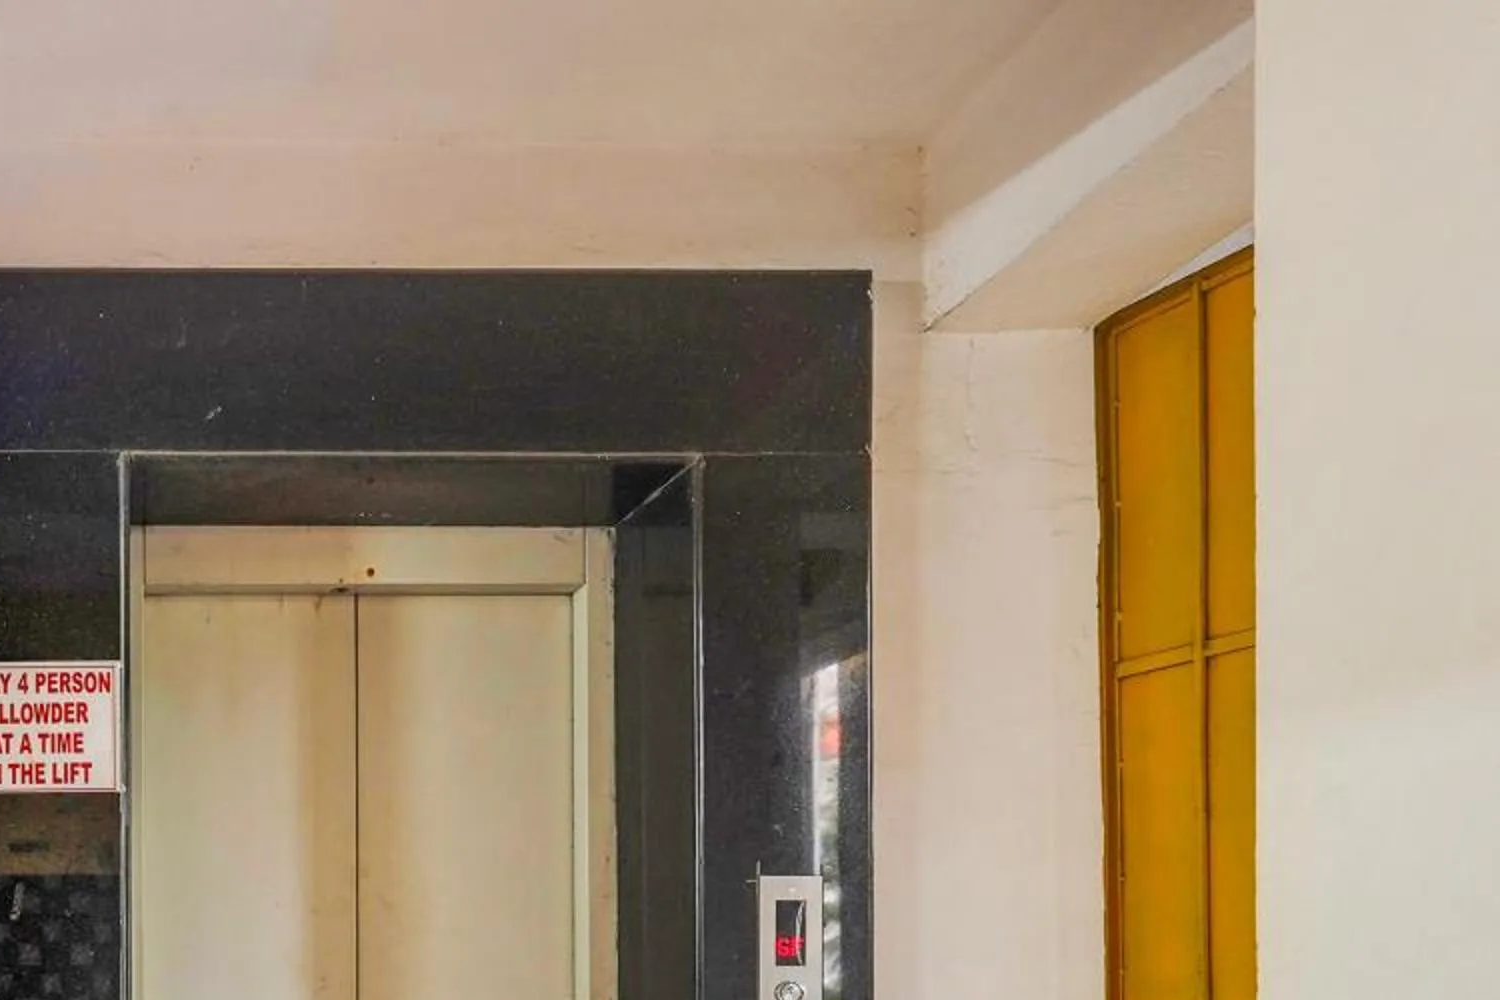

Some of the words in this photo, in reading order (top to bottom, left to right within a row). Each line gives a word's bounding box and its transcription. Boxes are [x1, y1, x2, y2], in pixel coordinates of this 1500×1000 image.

[17, 672, 29, 694] 4
[35, 671, 112, 694] PERSON
[19, 733, 32, 755] A
[38, 732, 84, 754] TIME
[8, 762, 46, 785] THE
[52, 762, 93, 785] LIFT
